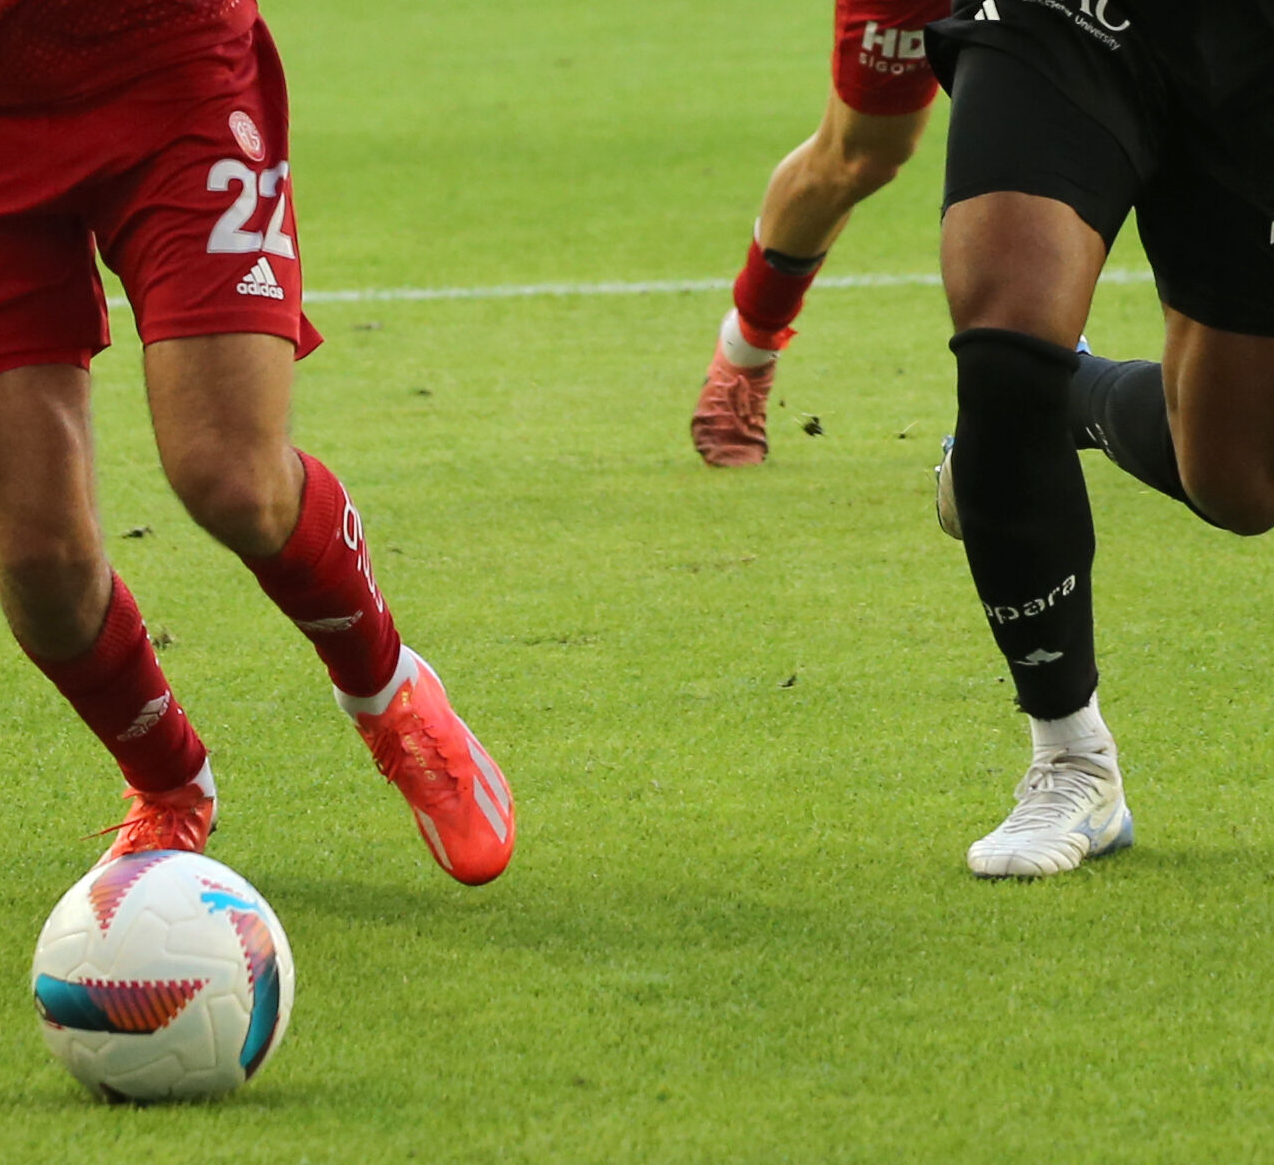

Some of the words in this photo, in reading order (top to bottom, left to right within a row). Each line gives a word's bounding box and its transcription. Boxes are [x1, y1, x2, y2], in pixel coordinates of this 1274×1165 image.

[1074, 14, 1122, 51] University
[206, 158, 296, 260] 22
[236, 281, 285, 302] adidas
[983, 574, 1076, 625] para
